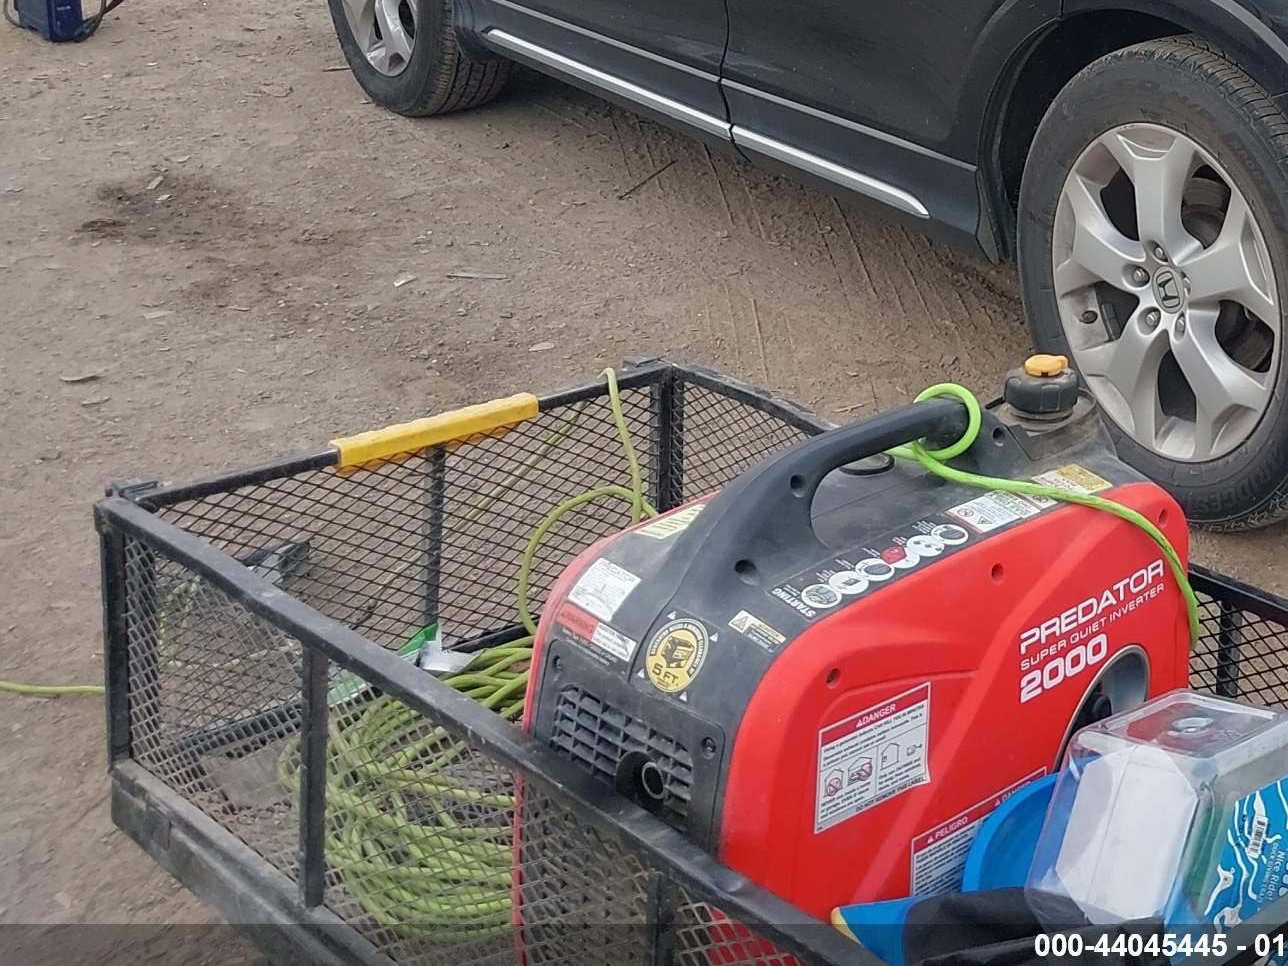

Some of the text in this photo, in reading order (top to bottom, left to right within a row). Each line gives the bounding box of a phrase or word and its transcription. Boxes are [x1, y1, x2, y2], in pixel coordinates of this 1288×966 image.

[771, 588, 816, 618] STARTING
[1020, 559, 1164, 655] PREDATOR
[1021, 583, 1164, 671] SUPER QUIET INVERTER
[652, 662, 664, 676] 5
[1020, 634, 1108, 704] 2000
[862, 703, 897, 726] DANGER
[935, 816, 968, 839] PELIGRO
[1273, 850, 1285, 872] Nice
